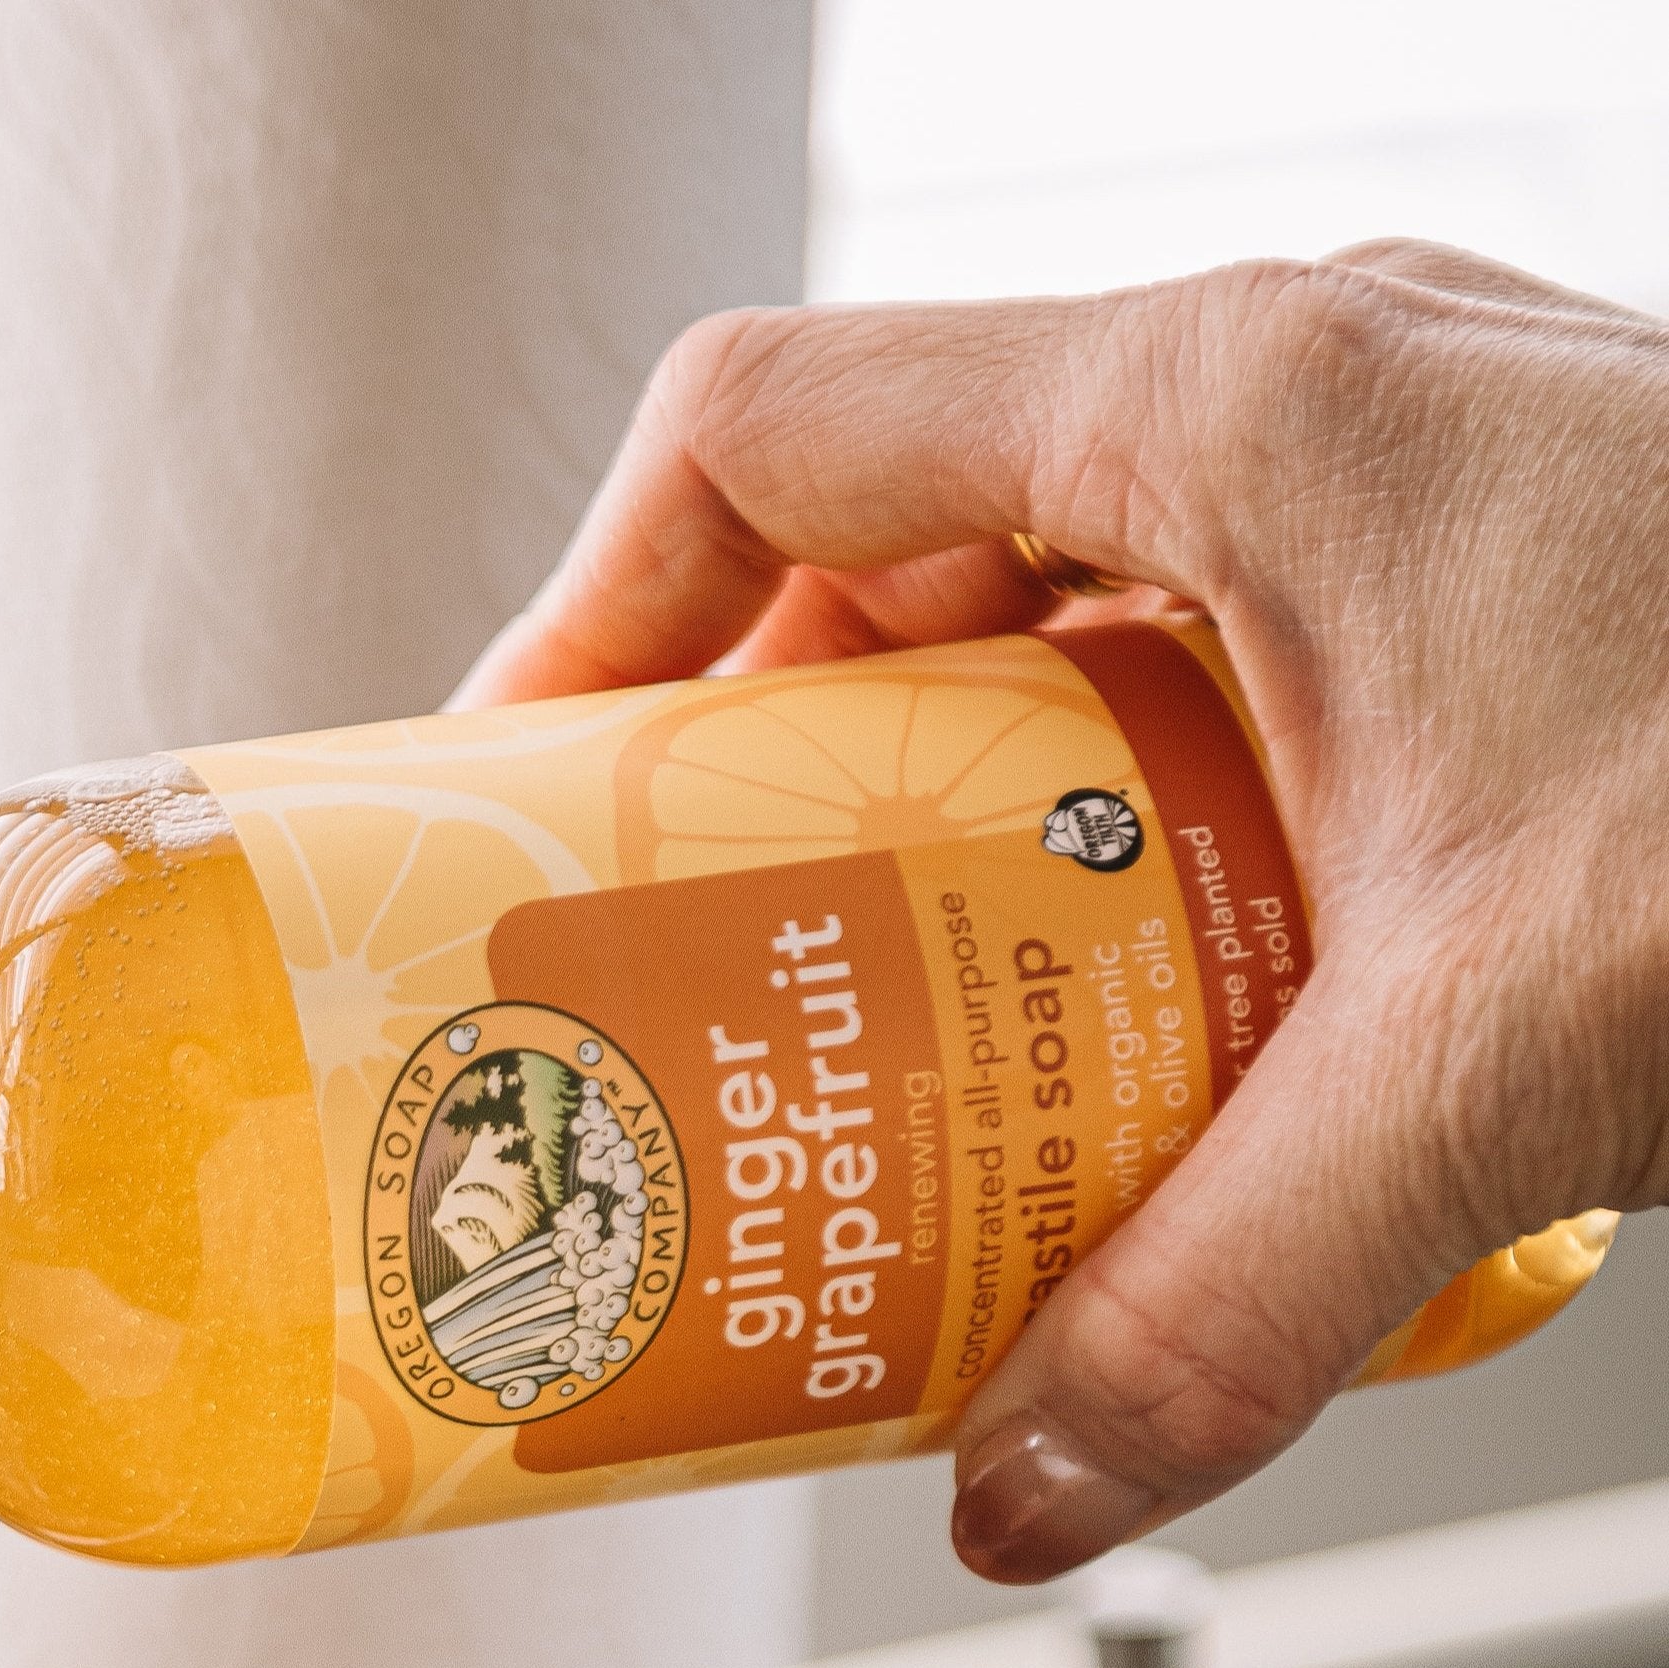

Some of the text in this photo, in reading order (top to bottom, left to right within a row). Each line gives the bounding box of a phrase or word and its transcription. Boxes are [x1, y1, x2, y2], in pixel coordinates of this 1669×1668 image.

[1130, 917, 1177, 990] oils
[1149, 1006, 1190, 1108] olive
[1178, 826, 1255, 1051] tree planted
[1248, 896, 1295, 974] sold
[703, 1025, 809, 1348] ginger
[770, 914, 902, 1399] grapefruit
[898, 1069, 942, 1265] renewing
[940, 892, 1010, 1380] concentrated all-purpose
[1013, 938, 1078, 1324] astile soap
[1088, 942, 1147, 1210] with organic
[377, 1064, 455, 1400] OREGON SOAP
